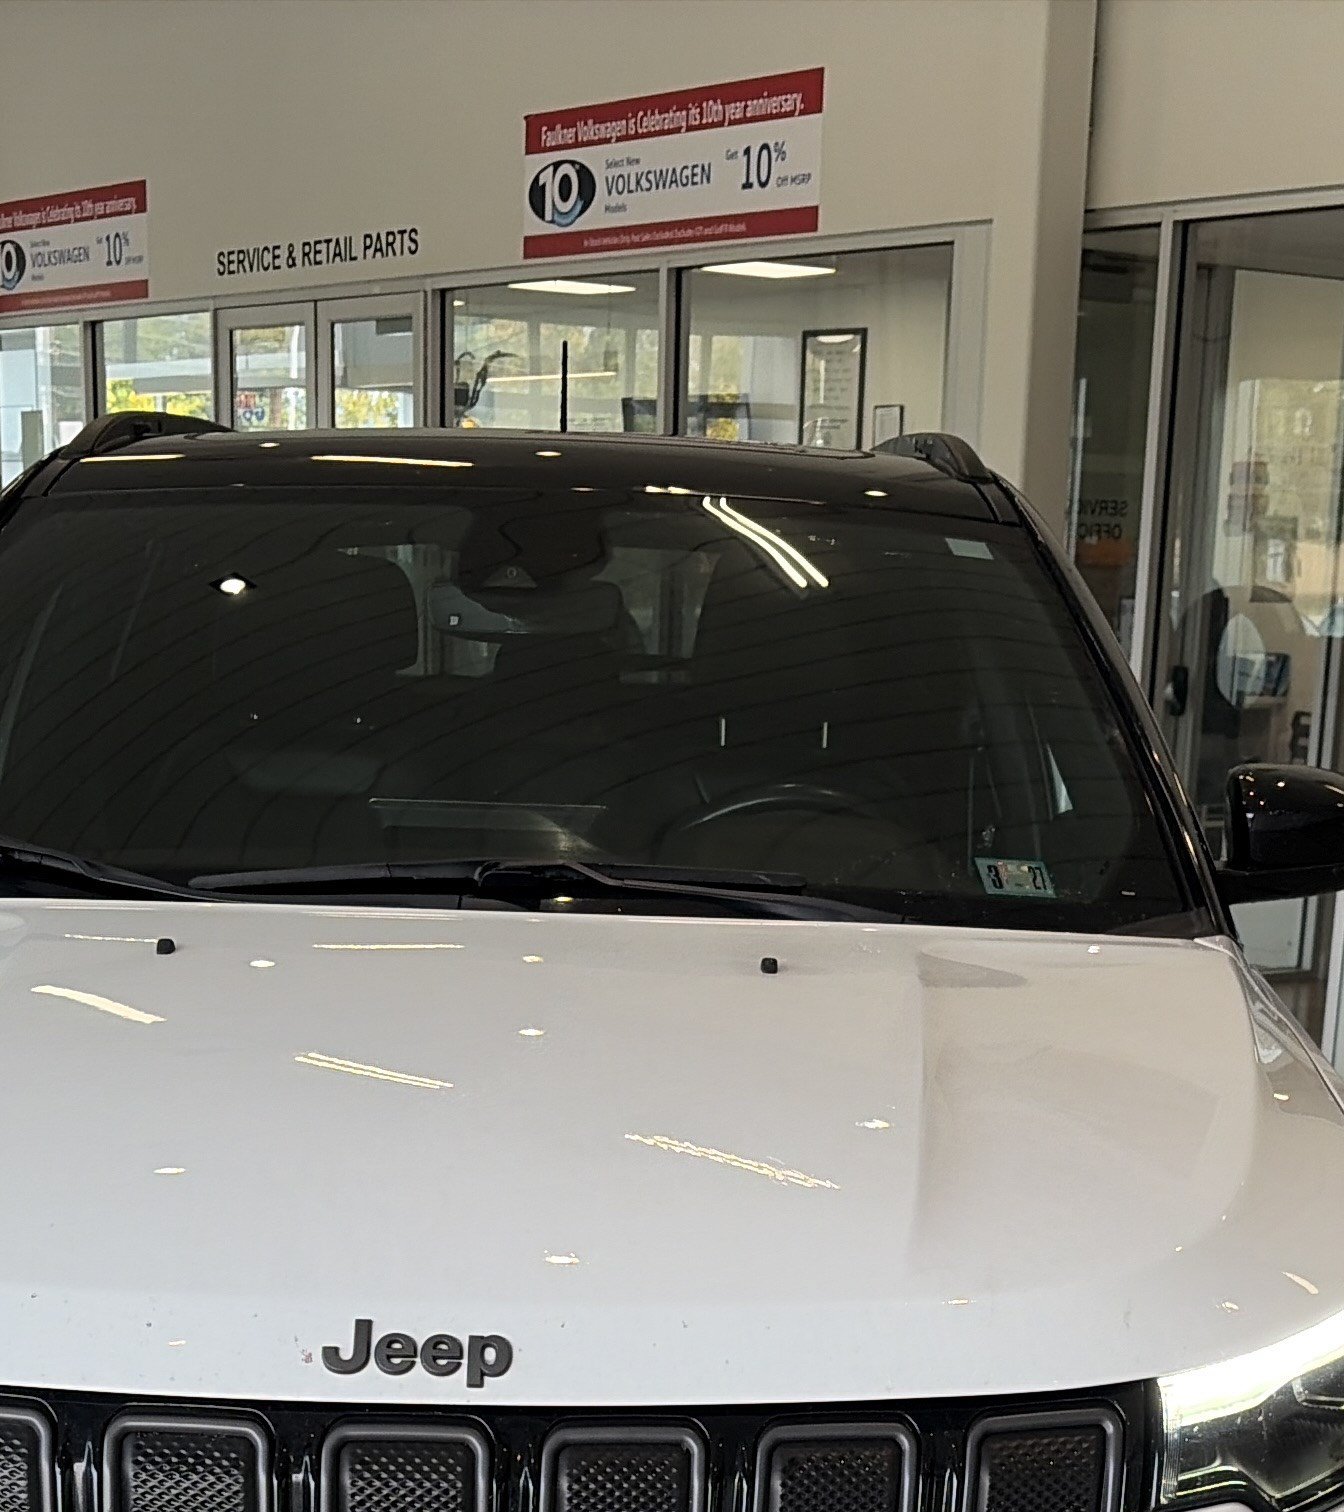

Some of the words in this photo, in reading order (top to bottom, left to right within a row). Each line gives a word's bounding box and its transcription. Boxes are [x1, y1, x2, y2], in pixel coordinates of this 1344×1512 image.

[577, 117, 626, 143] Volkswagen
[627, 112, 636, 135] is
[636, 104, 687, 133] Celebrating
[701, 98, 724, 124] 10th
[724, 100, 746, 127] year
[538, 162, 580, 223] 10
[604, 162, 712, 197] VOLKSWAGEN
[29, 246, 90, 269] VOLKSWAGEN
[216, 244, 281, 277] SERVICE
[286, 242, 297, 269] &
[301, 235, 358, 268] RETAIL
[362, 227, 419, 260] PARTS
[986, 864, 1004, 890] 3
[1027, 865, 1048, 891] 27
[321, 1318, 514, 1389] Jeep
